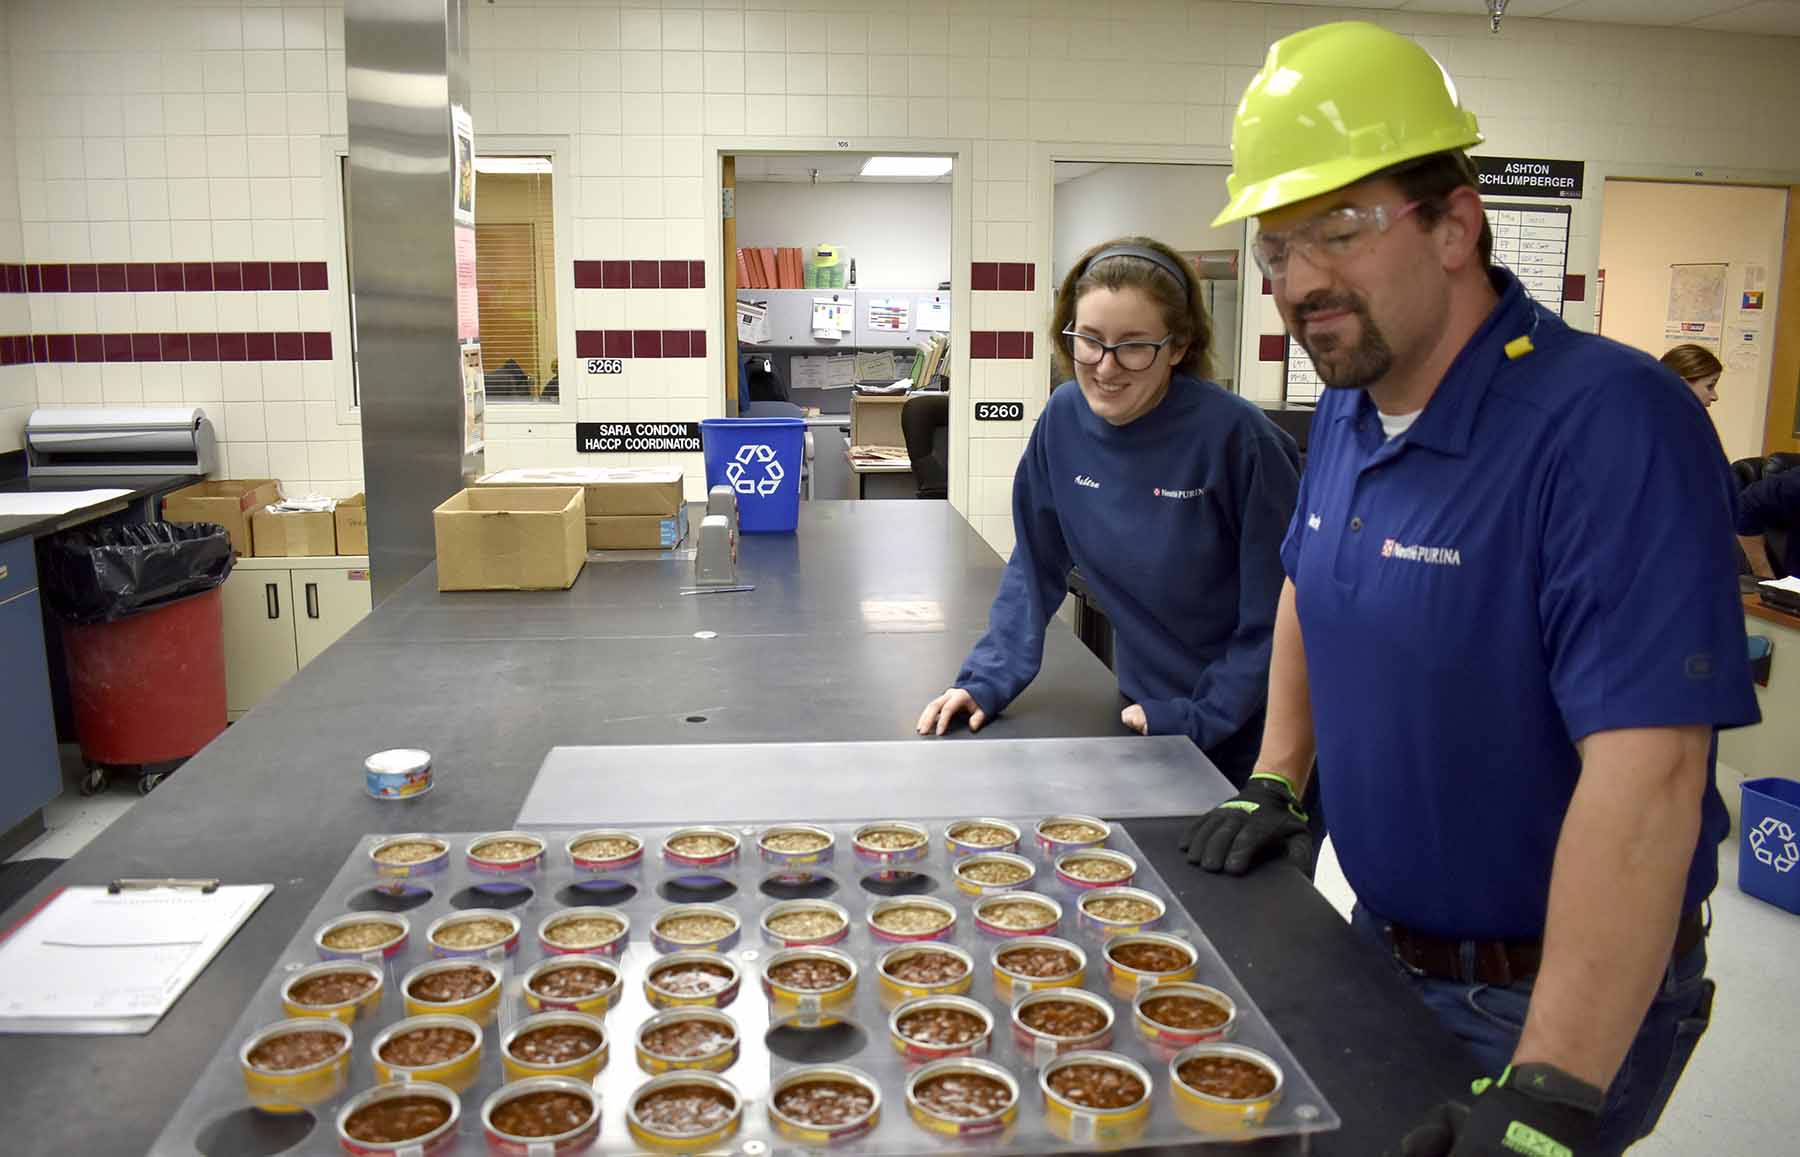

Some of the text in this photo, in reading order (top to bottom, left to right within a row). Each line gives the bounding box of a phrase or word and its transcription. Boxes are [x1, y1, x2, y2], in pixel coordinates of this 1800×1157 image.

[1505, 163, 1549, 174] ASHTON
[1478, 174, 1574, 187] SCHLUMPBERGER
[588, 360, 621, 373] 5266
[979, 405, 1019, 418] 5260
[600, 424, 687, 436] SARA CONDON
[585, 438, 700, 450] HACCP COORDINATOR
[1417, 546, 1461, 565] PURINA
